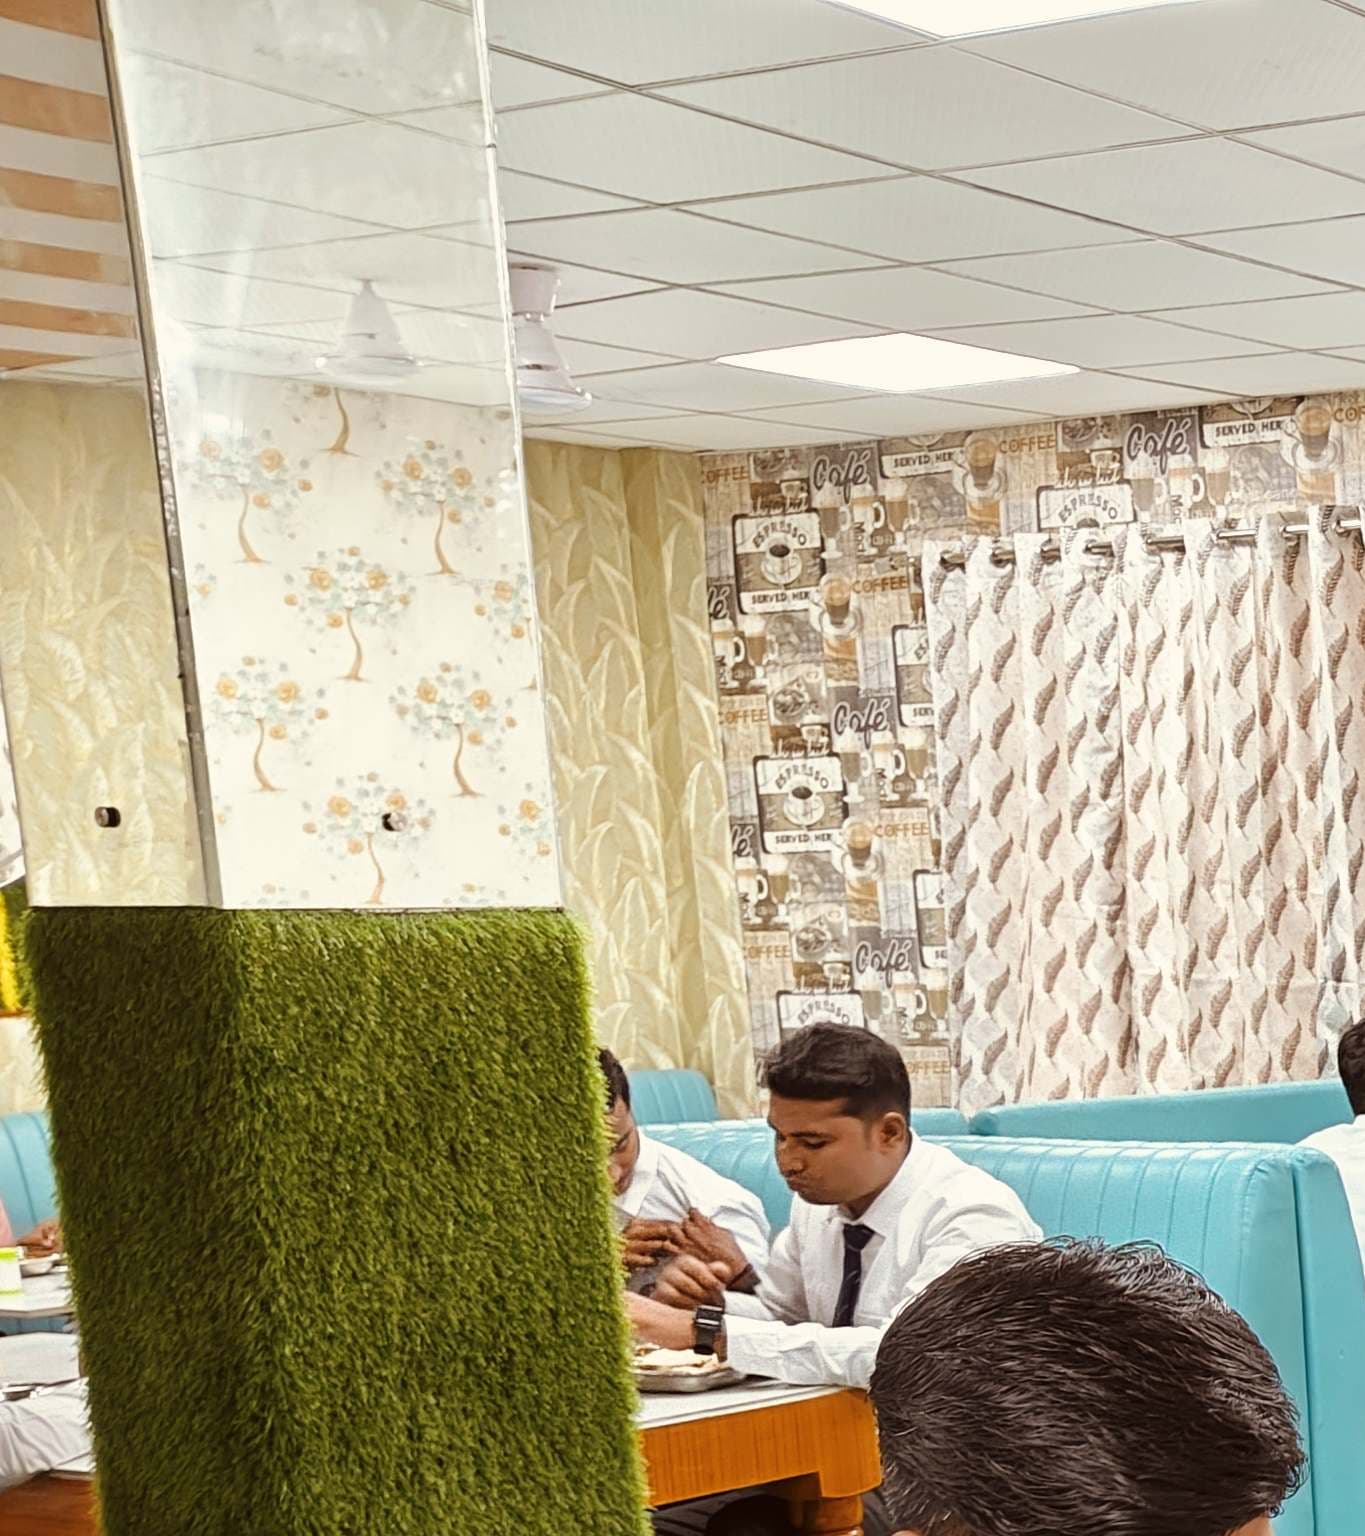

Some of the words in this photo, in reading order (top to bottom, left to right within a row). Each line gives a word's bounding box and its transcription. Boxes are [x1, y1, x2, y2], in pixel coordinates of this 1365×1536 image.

[1000, 434, 1056, 454] COFFEE
[1127, 418, 1191, 475] Café
[703, 466, 748, 484] OFFEE
[1058, 491, 1119, 523] ESPRESSO
[852, 576, 908, 594] COFFEE
[719, 708, 768, 725] OFFEE
[875, 822, 929, 838] COFFEE
